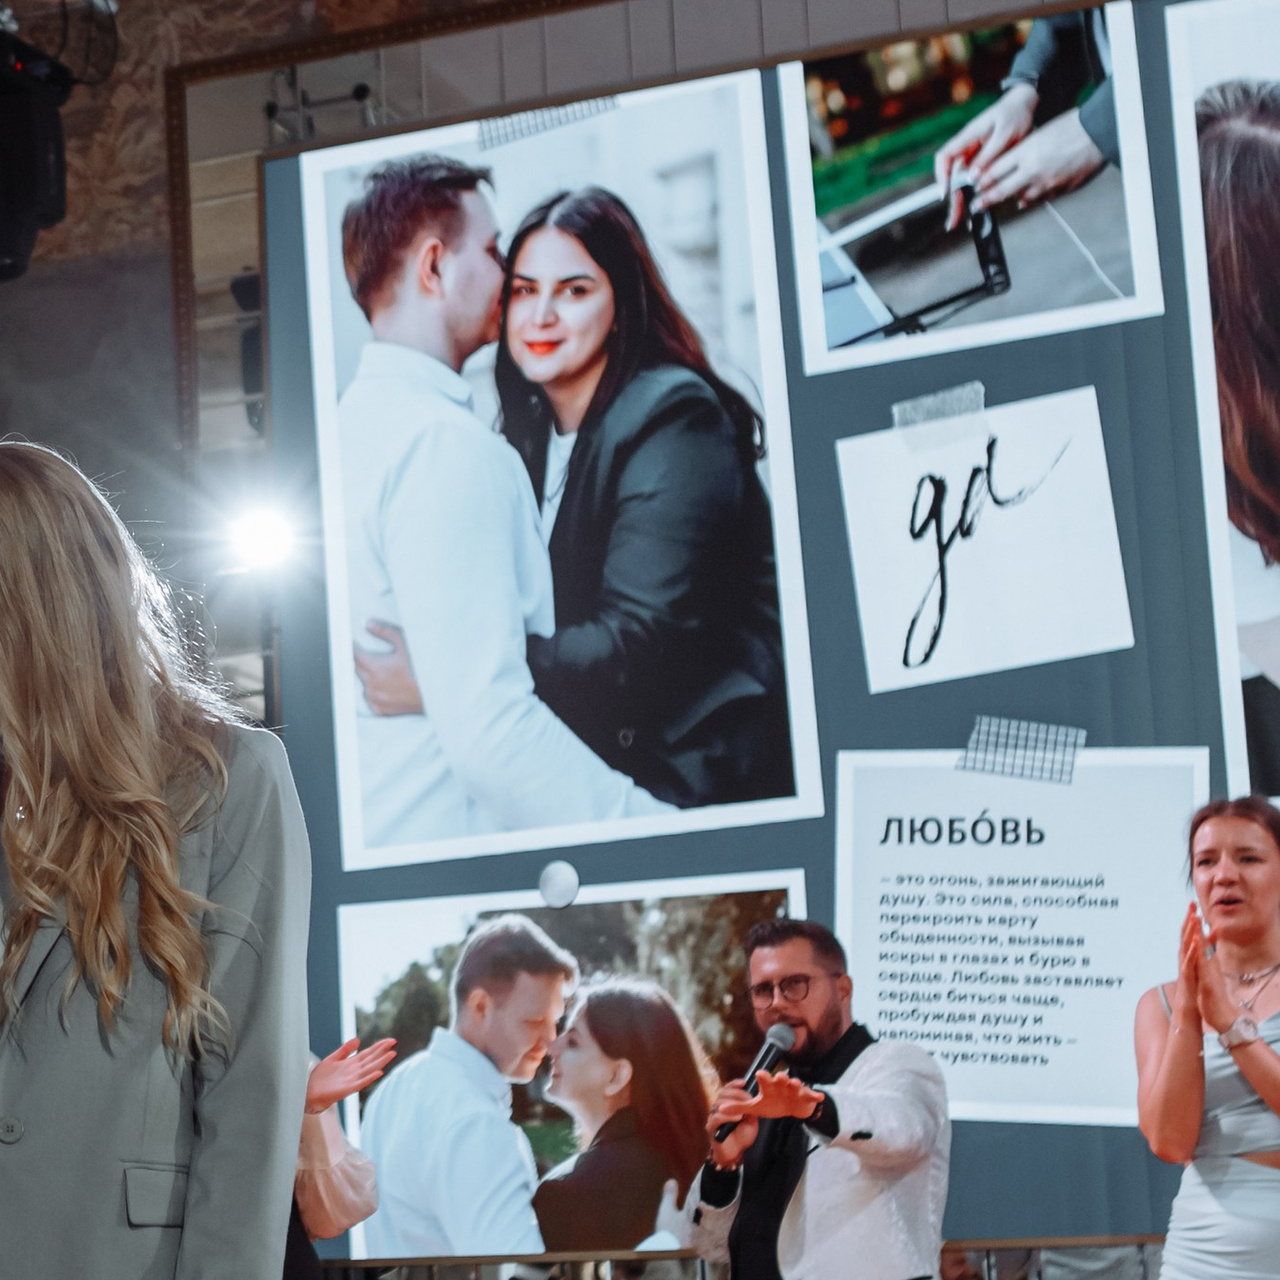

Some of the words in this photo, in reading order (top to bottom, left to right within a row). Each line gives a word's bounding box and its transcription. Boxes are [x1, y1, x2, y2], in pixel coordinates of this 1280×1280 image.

[896, 874, 925, 887] это
[936, 893, 966, 906] Это
[971, 894, 1018, 909] сила,
[1022, 893, 1119, 908] способная
[879, 913, 983, 927] перекроить
[988, 915, 1039, 930] карту
[1008, 934, 1085, 947] вызывая
[879, 951, 935, 965] искры
[940, 952, 948, 963] в
[952, 953, 1009, 965] глазах
[1014, 954, 1024, 965] и
[1029, 950, 1077, 967] бурю
[1082, 956, 1090, 967] в
[951, 970, 1019, 984] Любовь
[1023, 975, 1124, 988] заставляет
[878, 990, 942, 1004] сердце
[947, 989, 1007, 1003] биться
[878, 1008, 977, 1024] пробуждая
[981, 1013, 1028, 1028] душу
[1033, 1014, 1043, 1024] и
[983, 1033, 1013, 1044] что
[1017, 1033, 1062, 1046] жить
[940, 1050, 1049, 1066] чувствовать
